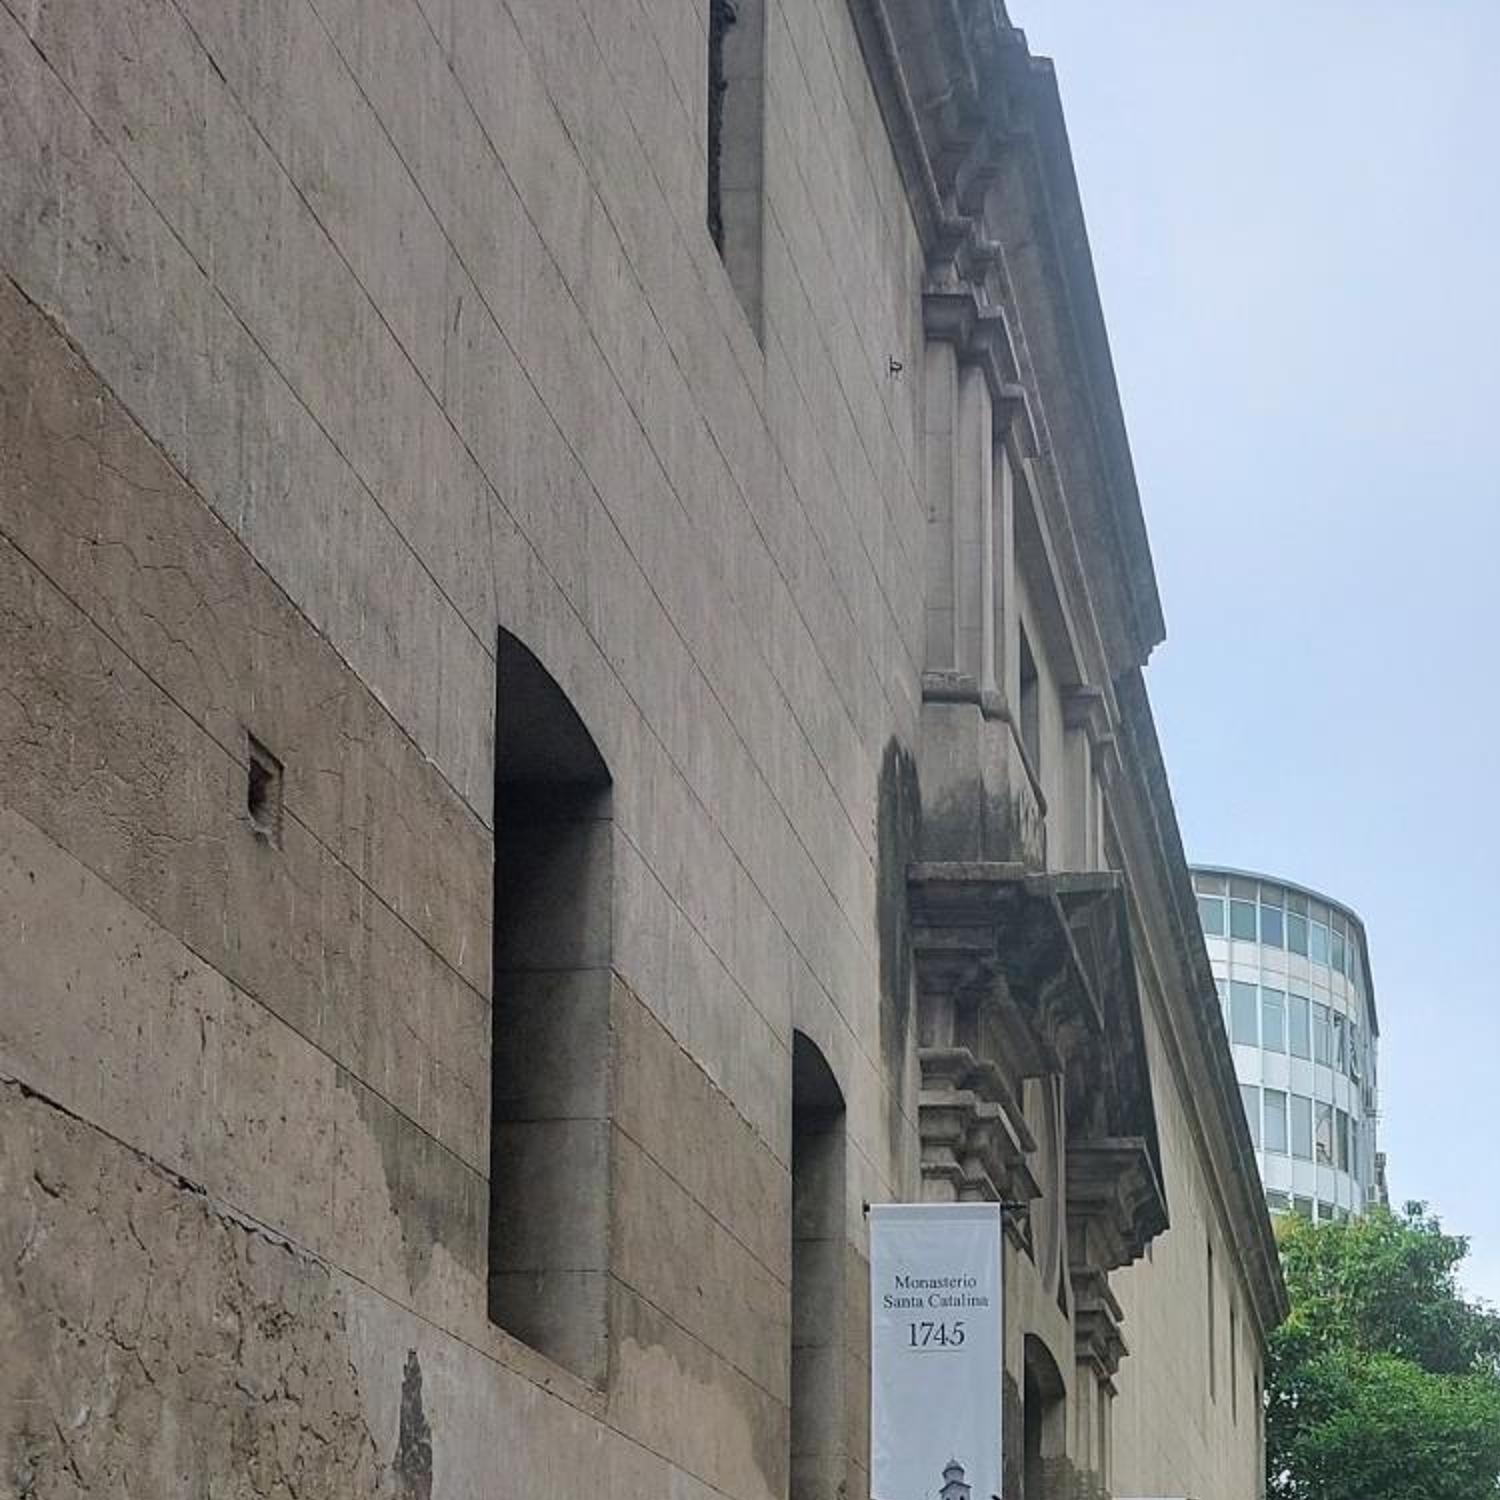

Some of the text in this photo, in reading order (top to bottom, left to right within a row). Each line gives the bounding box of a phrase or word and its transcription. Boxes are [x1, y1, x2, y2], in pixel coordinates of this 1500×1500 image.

[895, 1273, 977, 1289] Monasterio
[883, 1293, 989, 1309] Santa Catalina
[907, 1321, 965, 1347] 1745
